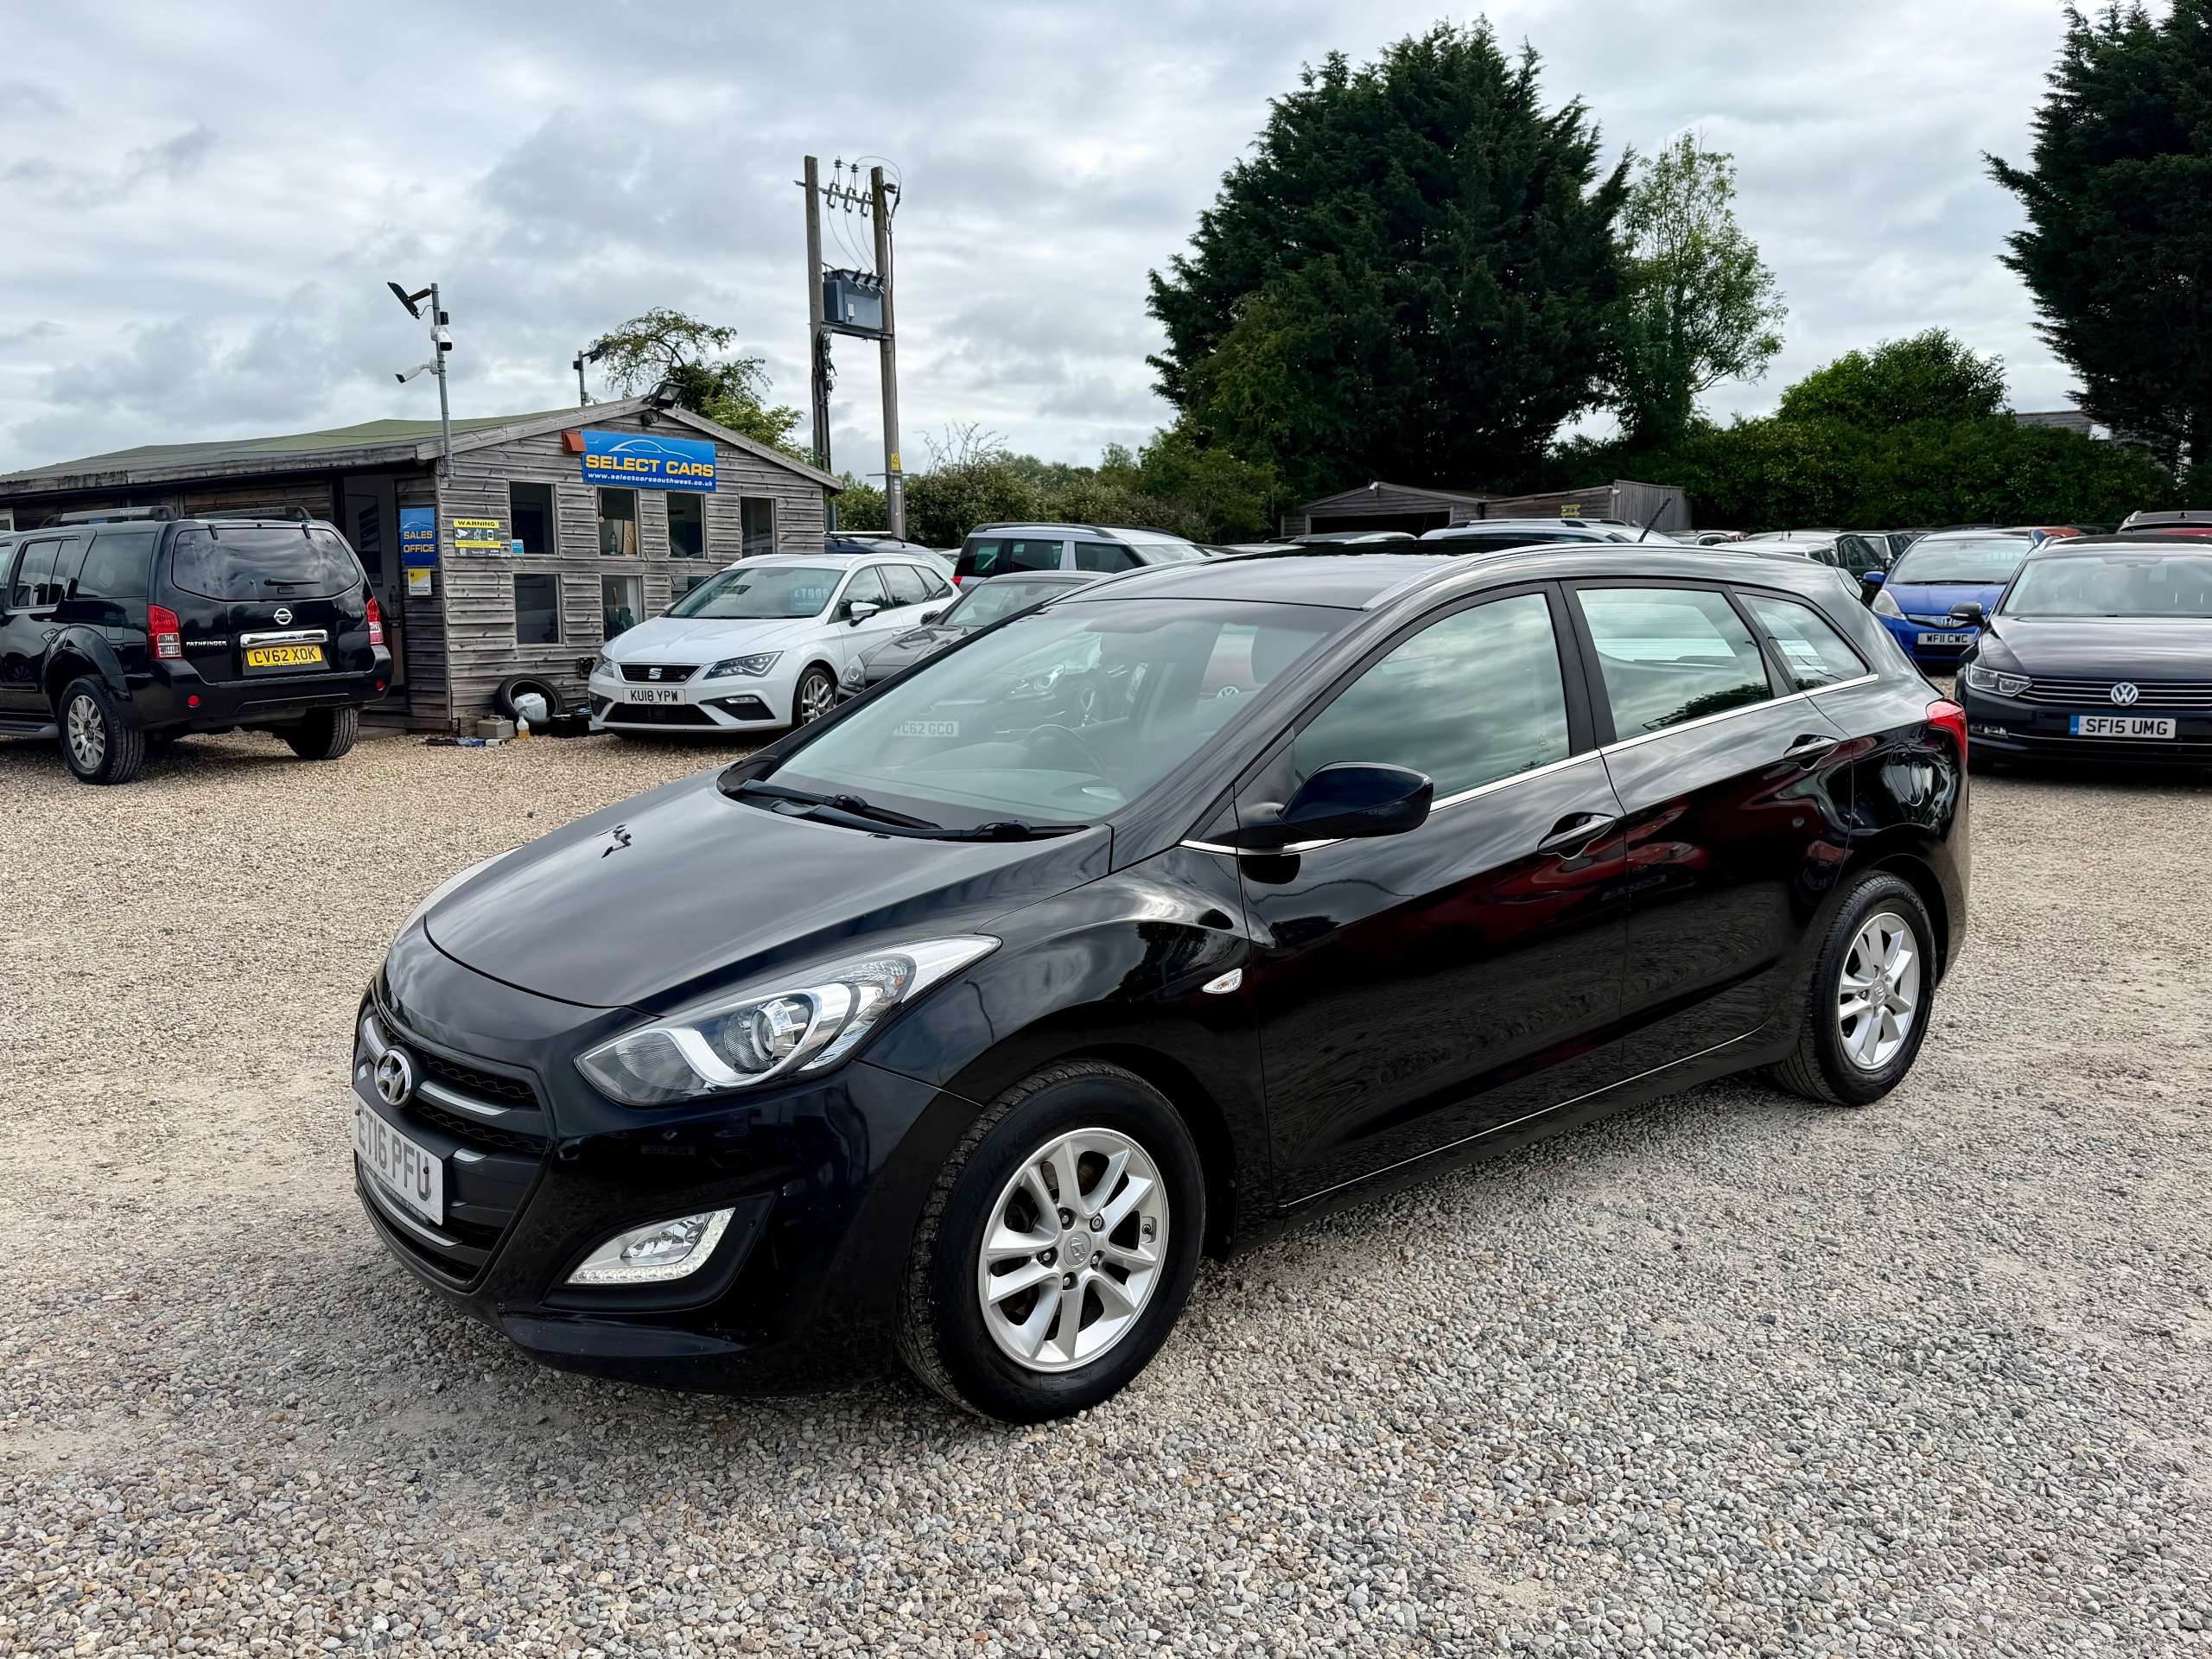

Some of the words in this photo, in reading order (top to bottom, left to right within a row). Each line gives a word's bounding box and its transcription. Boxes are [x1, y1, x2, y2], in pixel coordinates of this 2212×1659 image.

[586, 454, 660, 473] SELECT
[665, 461, 715, 478] CARS
[404, 530, 433, 540] SALES
[403, 543, 435, 553] OFFICE
[1927, 633, 1945, 643] WF11
[1948, 634, 1968, 643] CWC
[253, 650, 289, 664] CV62
[293, 647, 317, 661] XOK
[630, 690, 654, 702] KU18
[657, 690, 678, 702] YPW
[928, 722, 954, 734] GCO
[2085, 719, 2126, 734] SF15
[2132, 720, 2168, 735] UMG
[358, 1102, 388, 1170] ET16
[391, 1133, 431, 1202] PFU
